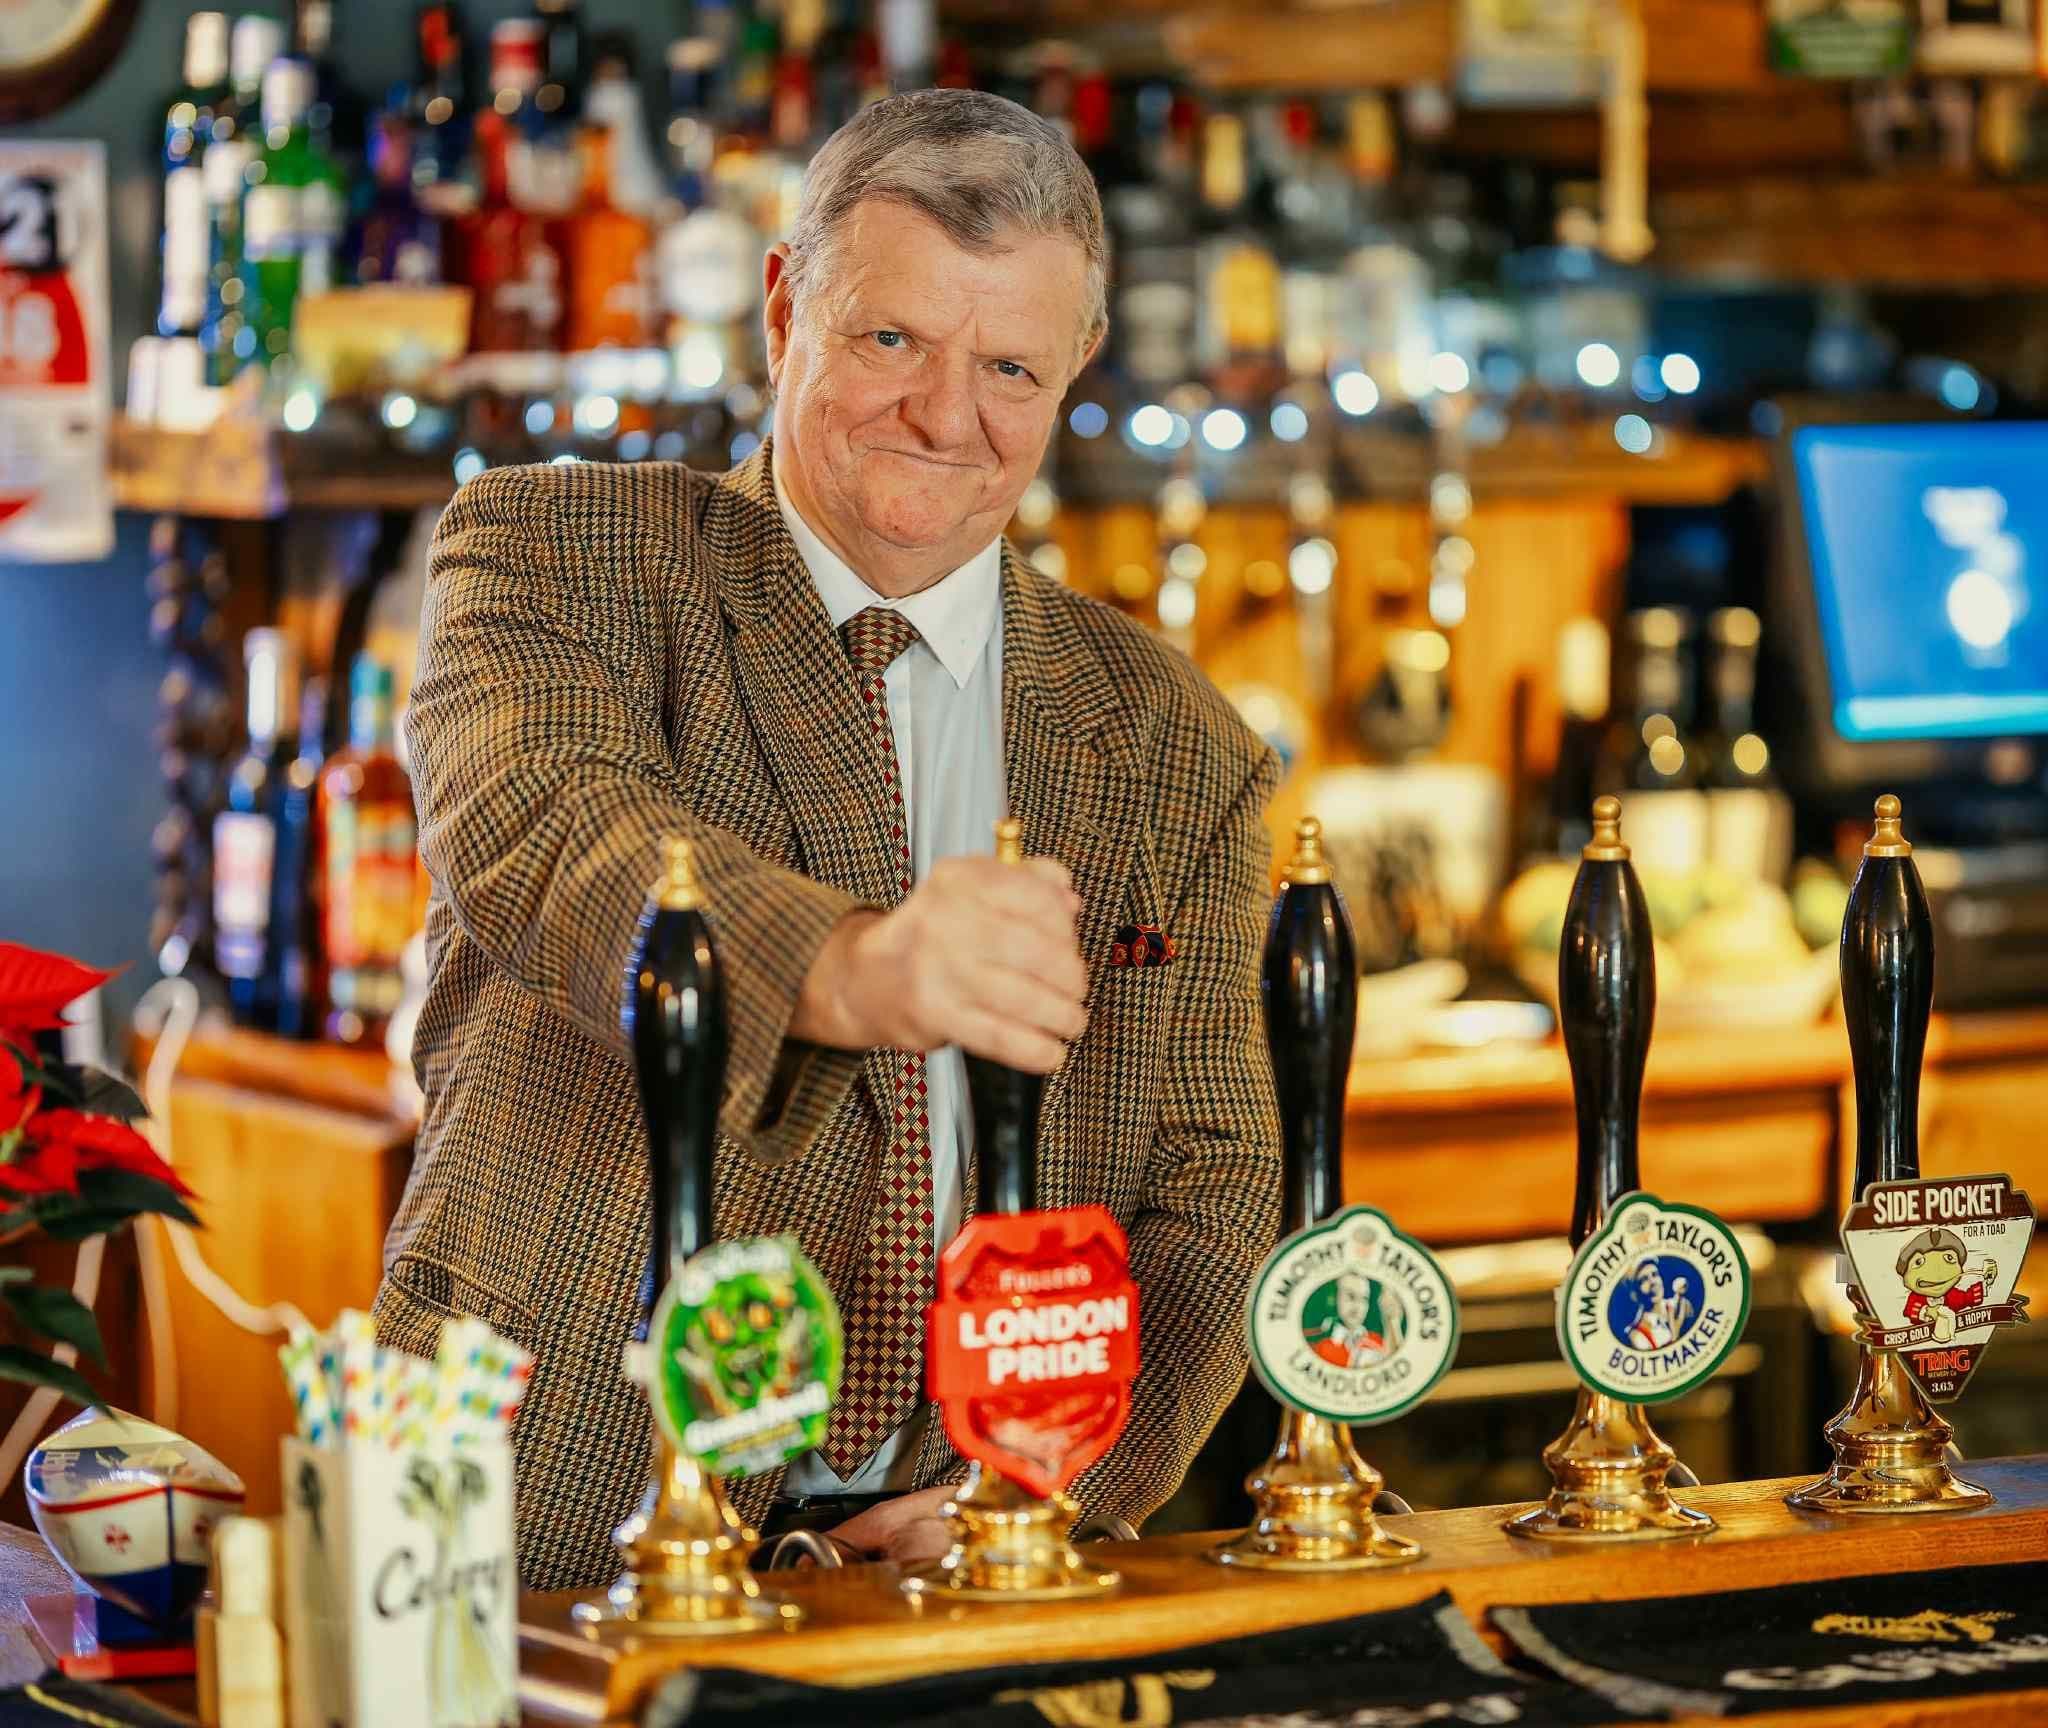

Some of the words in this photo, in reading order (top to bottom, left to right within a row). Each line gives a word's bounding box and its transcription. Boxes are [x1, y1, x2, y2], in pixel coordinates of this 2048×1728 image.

[1872, 1189, 1922, 1224] SIDE
[1925, 1183, 2005, 1221] POCKET
[1963, 1225, 1978, 1238] FOR
[1979, 1224, 1985, 1237] A
[1986, 1223, 2006, 1236] TOAD
[1268, 1241, 1346, 1321] TIMOTHY
[1379, 1245, 1443, 1340] TAYLOR'S
[1579, 1235, 1629, 1343] TIMOTHY
[1655, 1220, 1733, 1289] TAYLOR'S
[958, 1294, 1129, 1350] LONDON
[1608, 1307, 1724, 1377] BOLTMAKER
[1884, 1331, 1909, 1346] CRISP,
[1910, 1326, 1930, 1341] GOLD
[1965, 1309, 1993, 1326] HOPPY
[987, 1337, 1110, 1386] PRIDE
[1288, 1349, 1412, 1397] LANDLORD
[1912, 1349, 1971, 1377] TRING
